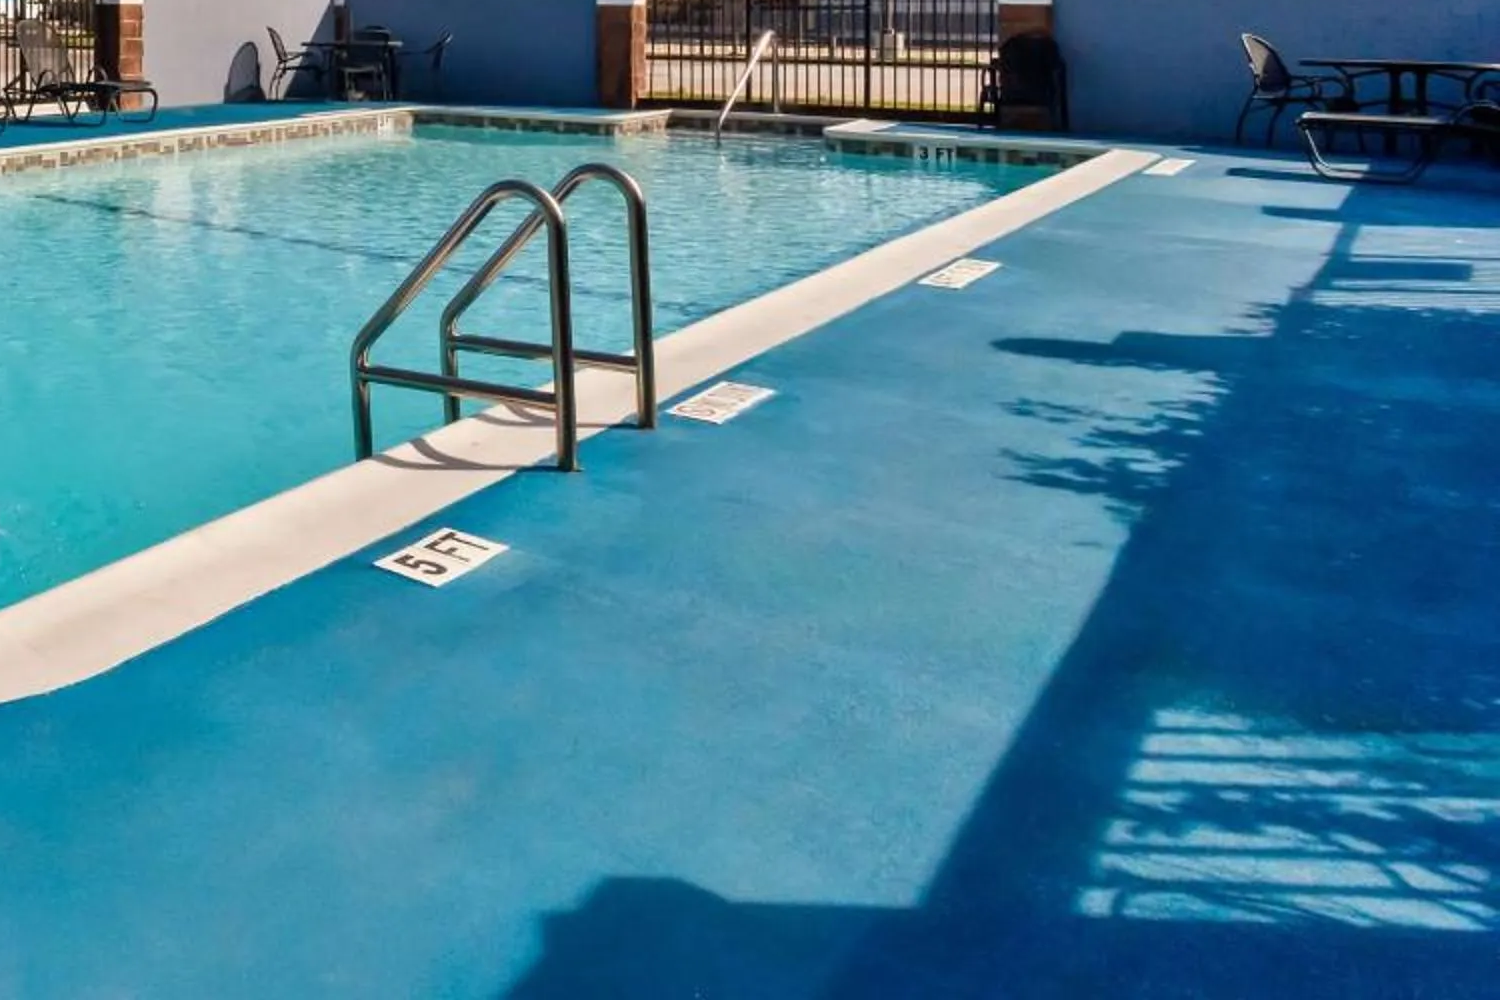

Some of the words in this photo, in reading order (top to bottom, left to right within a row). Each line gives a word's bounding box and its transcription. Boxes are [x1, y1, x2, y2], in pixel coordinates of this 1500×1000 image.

[936, 147, 955, 162] FT
[393, 553, 448, 575] 5
[423, 531, 490, 563] FT
